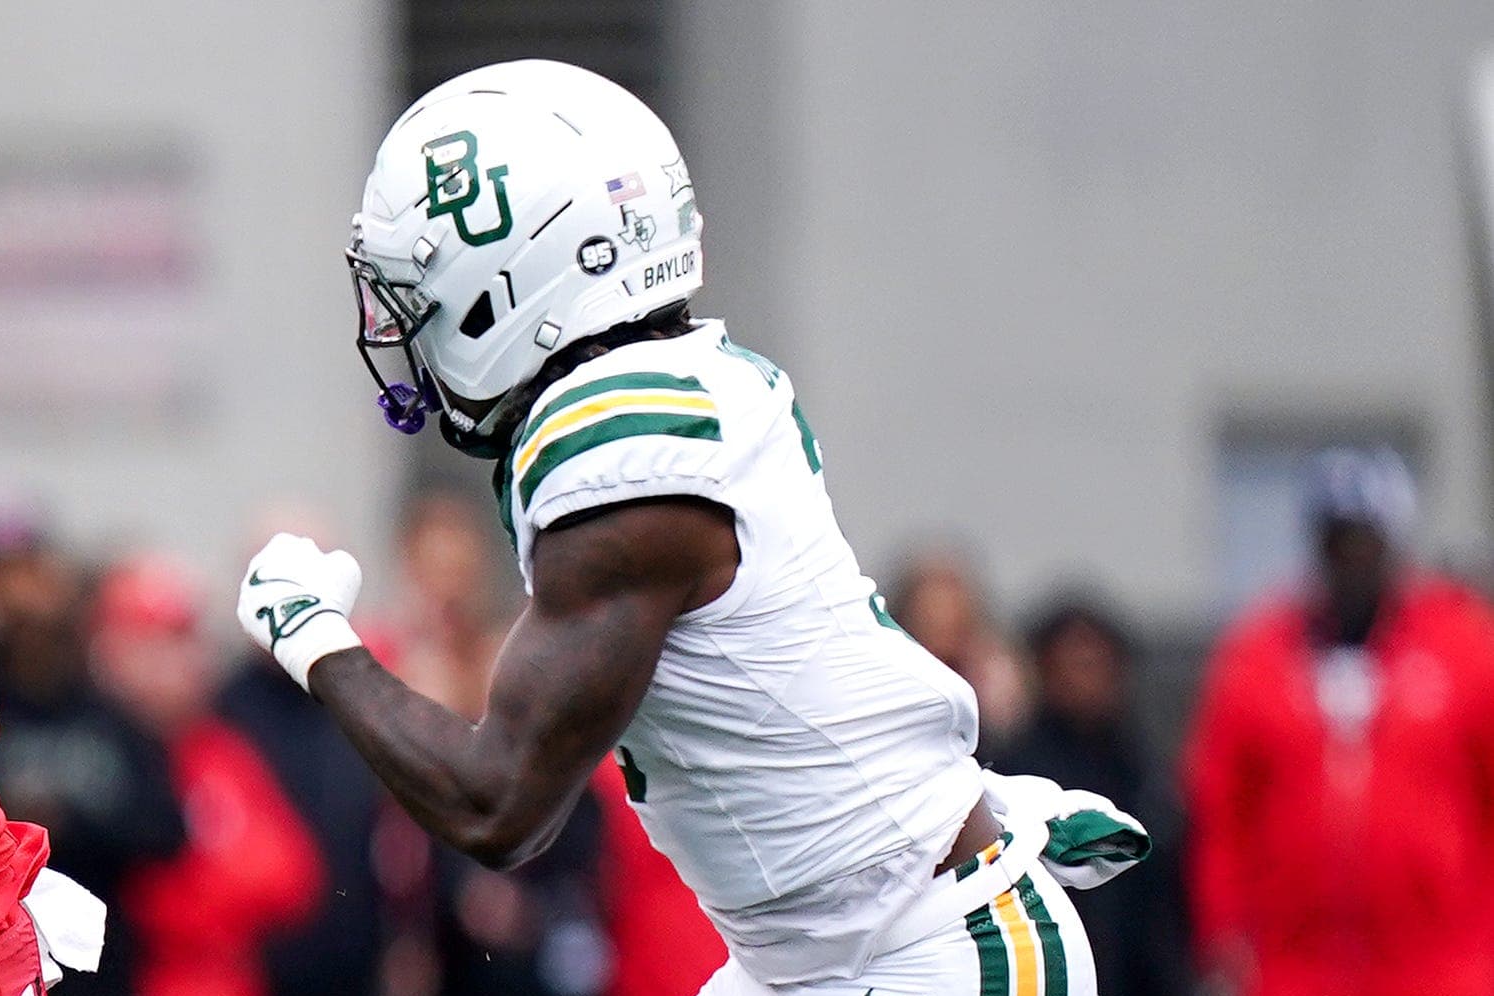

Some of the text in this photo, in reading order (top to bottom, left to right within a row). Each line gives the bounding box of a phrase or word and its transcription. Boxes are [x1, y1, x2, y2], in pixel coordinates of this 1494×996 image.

[423, 130, 513, 247] BU
[582, 241, 612, 269] 95
[644, 250, 695, 290] BAYLOR
